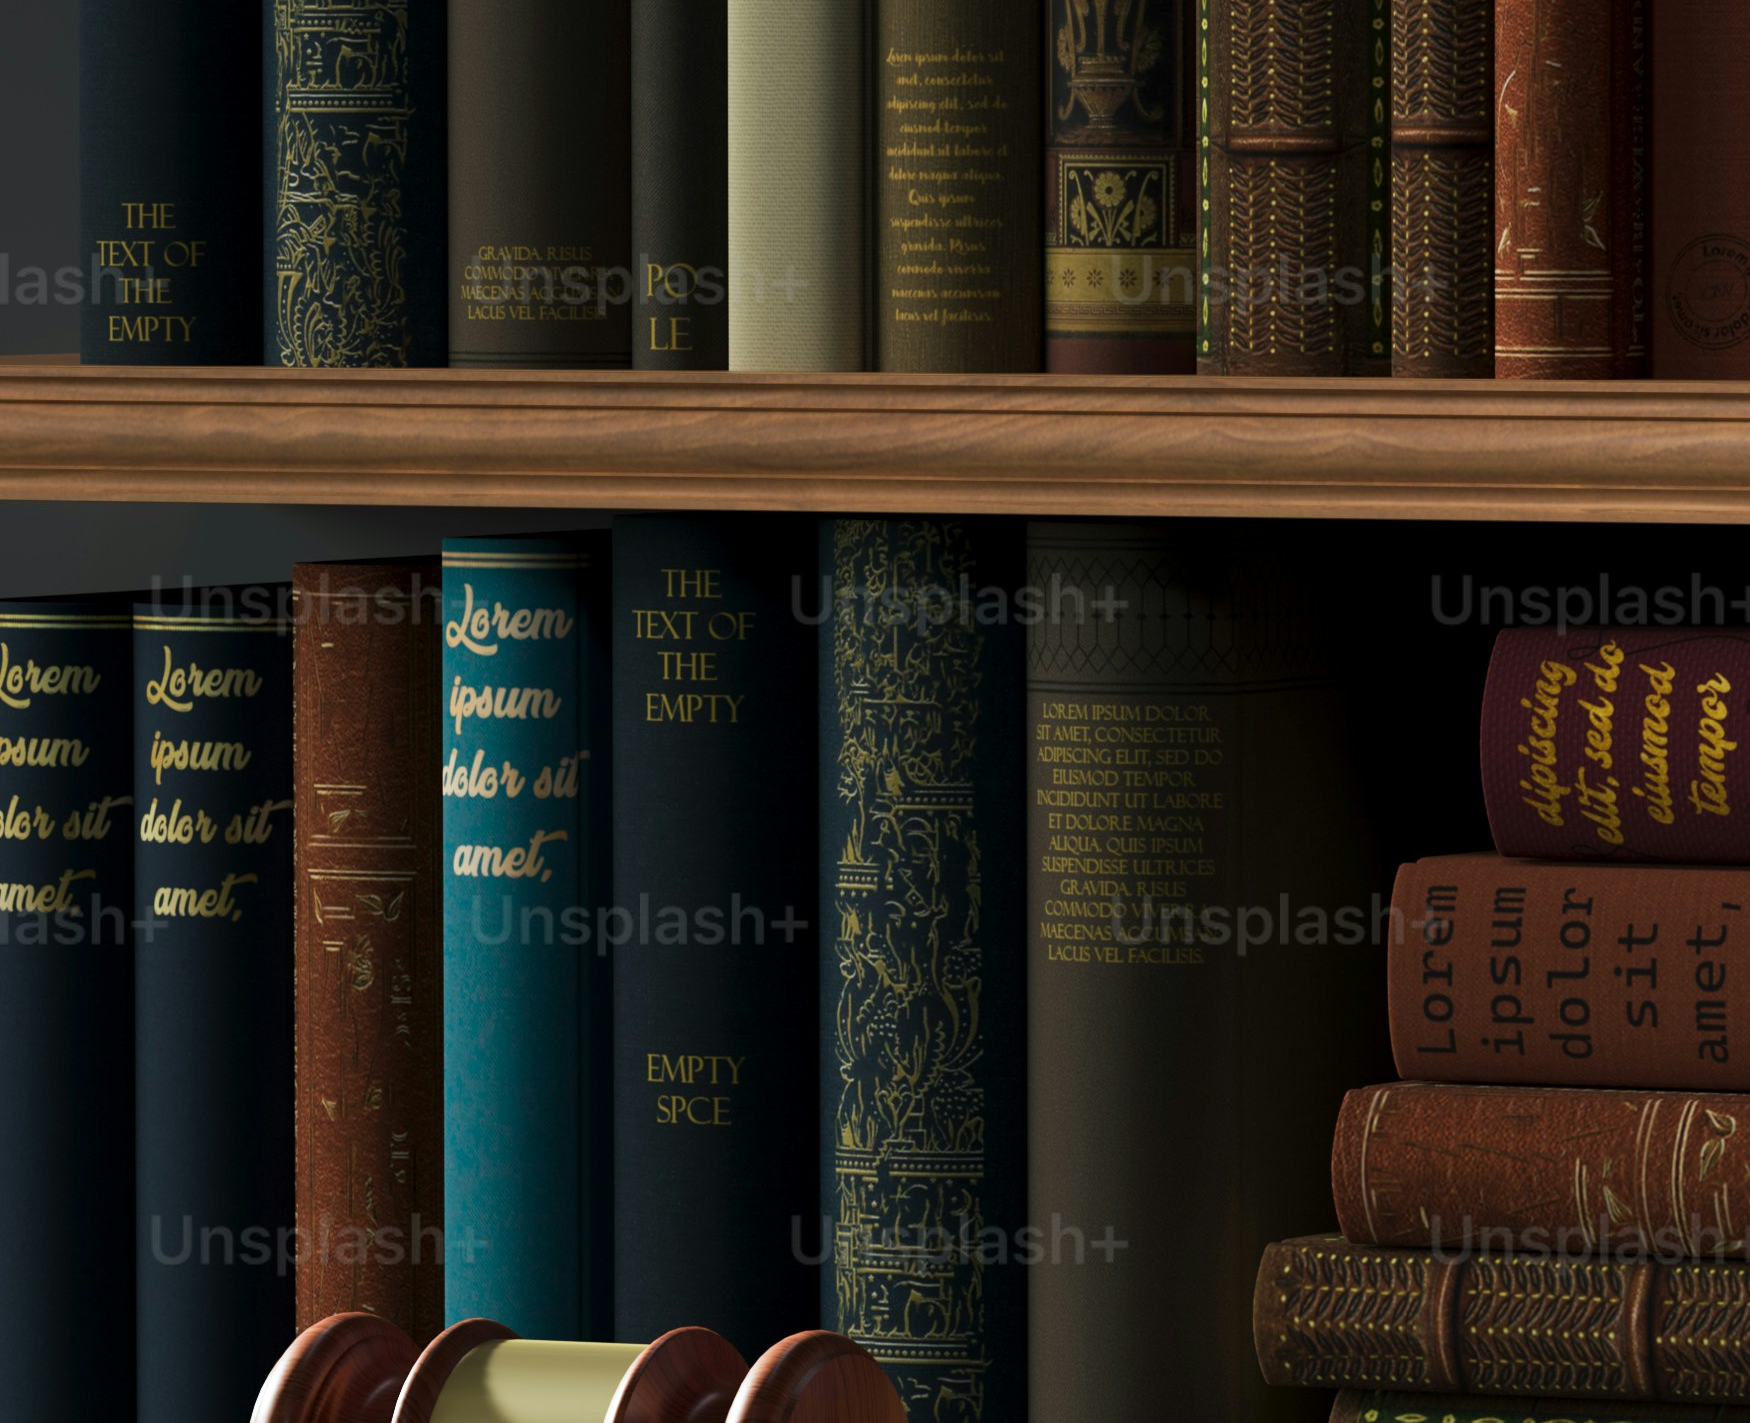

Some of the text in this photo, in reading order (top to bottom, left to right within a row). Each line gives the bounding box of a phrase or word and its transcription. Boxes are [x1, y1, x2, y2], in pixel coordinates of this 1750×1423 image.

[121, 201, 177, 232] THE
[96, 240, 207, 269] TEXT OF
[646, 261, 699, 299] PO
[120, 277, 173, 307] THE
[108, 314, 196, 345] EMPTY
[650, 316, 692, 351] LE
[662, 566, 723, 601] THE
[446, 582, 575, 657] Lorem
[632, 609, 757, 642] TEXT OF
[146, 645, 264, 713] Lorem
[656, 650, 720, 682] THE
[1583, 639, 1626, 694] do
[450, 675, 562, 736] ipsum
[644, 691, 746, 724] EMPTY
[150, 730, 253, 786] ipsum
[1577, 696, 1616, 770] sed
[1631, 660, 1677, 826] eiusmod
[1688, 671, 1739, 818] tempor
[441, 747, 592, 799] dolor sit
[140, 797, 293, 845] dolor sit
[1417, 885, 1459, 1055] Lorem
[1481, 887, 1535, 1057] ipsum
[1547, 887, 1594, 1060] dolor
[1613, 922, 1659, 1029] sit
[1686, 902, 1742, 1064] amet,
[646, 1053, 744, 1086] EMPTY
[656, 1093, 732, 1127] SPCE
